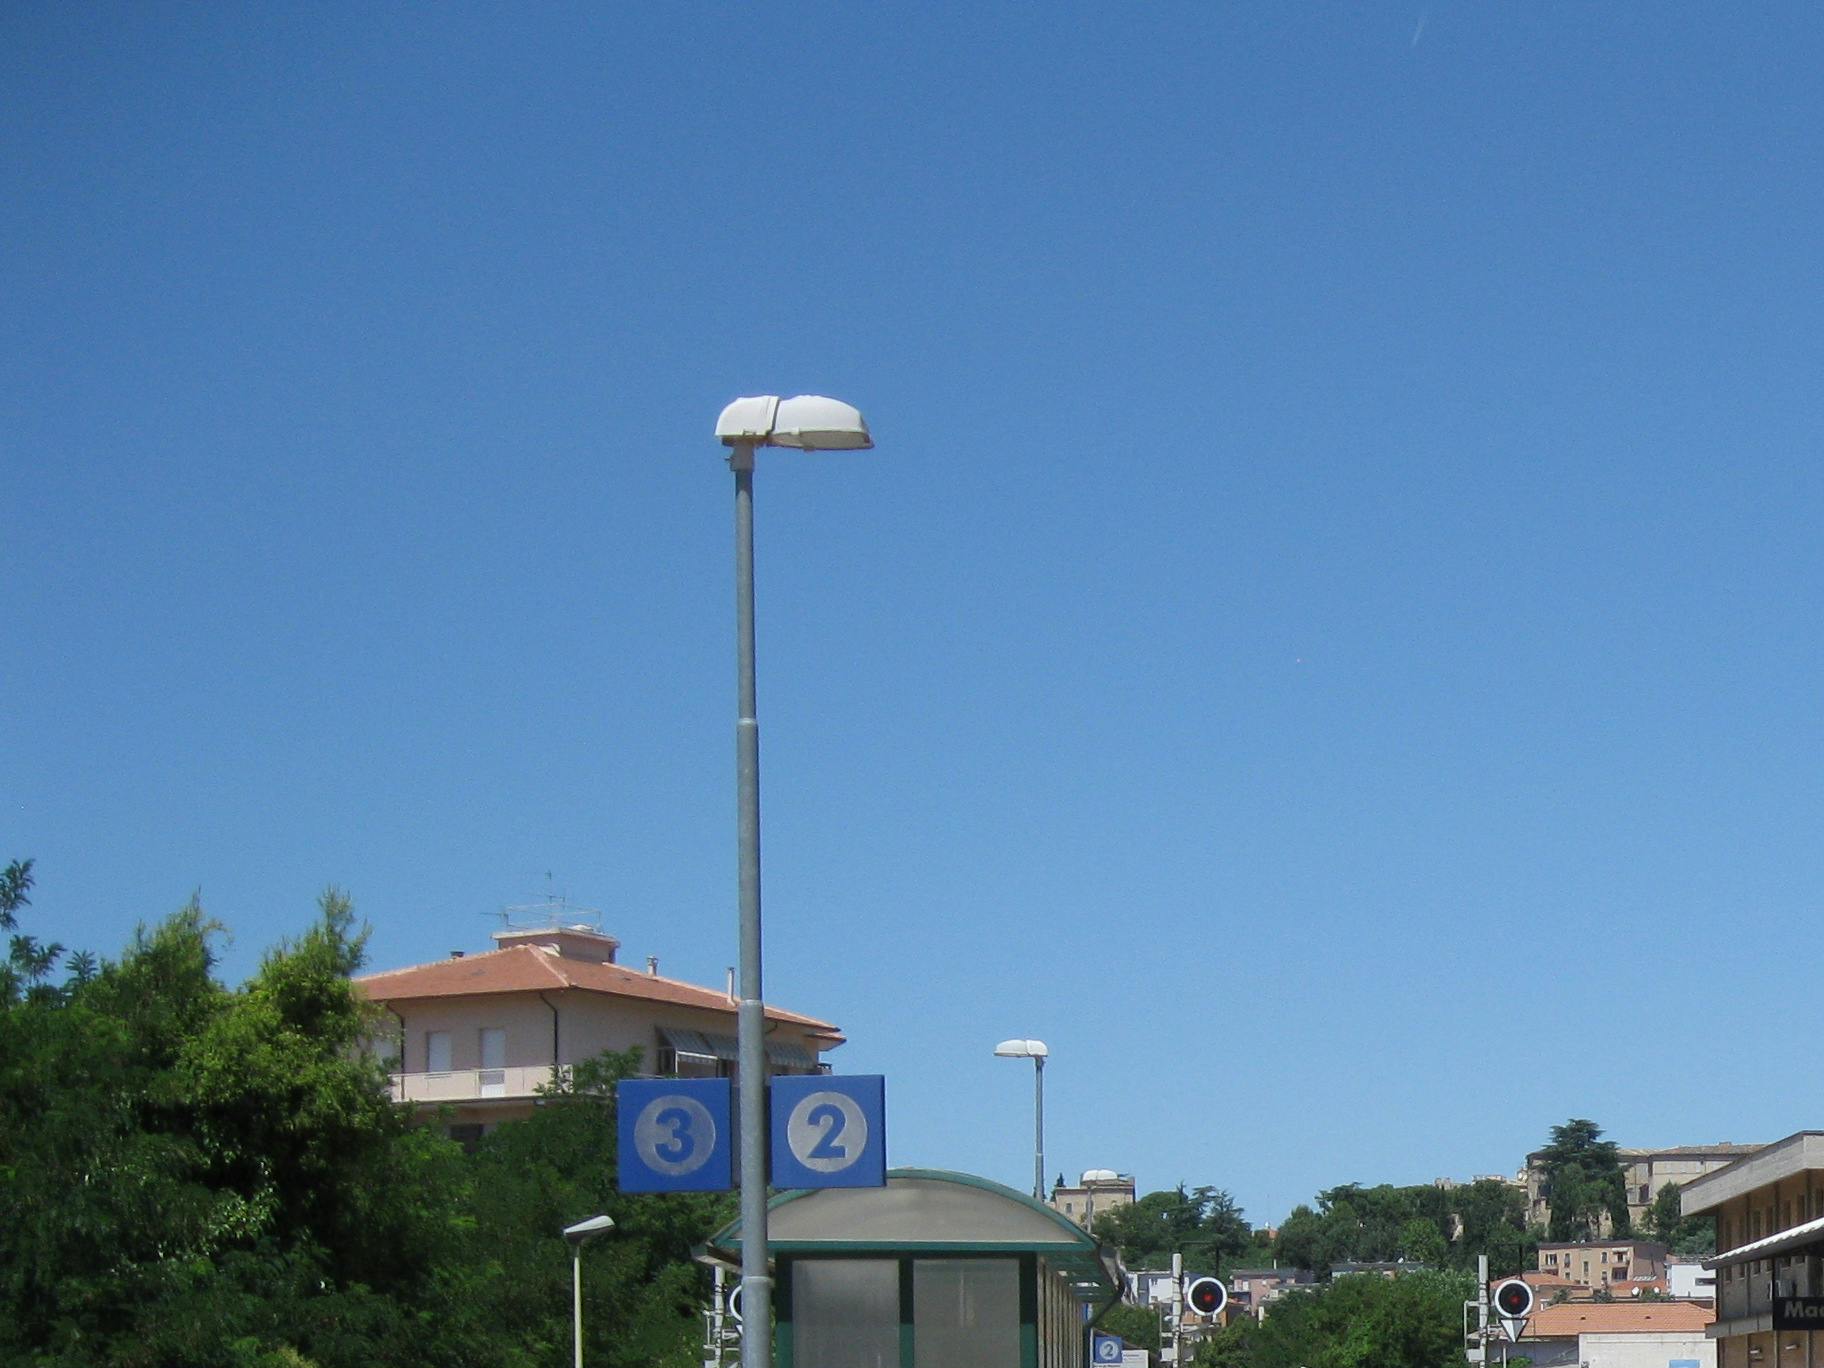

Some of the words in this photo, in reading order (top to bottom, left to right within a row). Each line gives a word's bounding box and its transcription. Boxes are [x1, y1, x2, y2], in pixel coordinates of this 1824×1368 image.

[654, 1107, 695, 1163] 3
[807, 1103, 847, 1159] 2
[1103, 1343, 1114, 1357] 2
